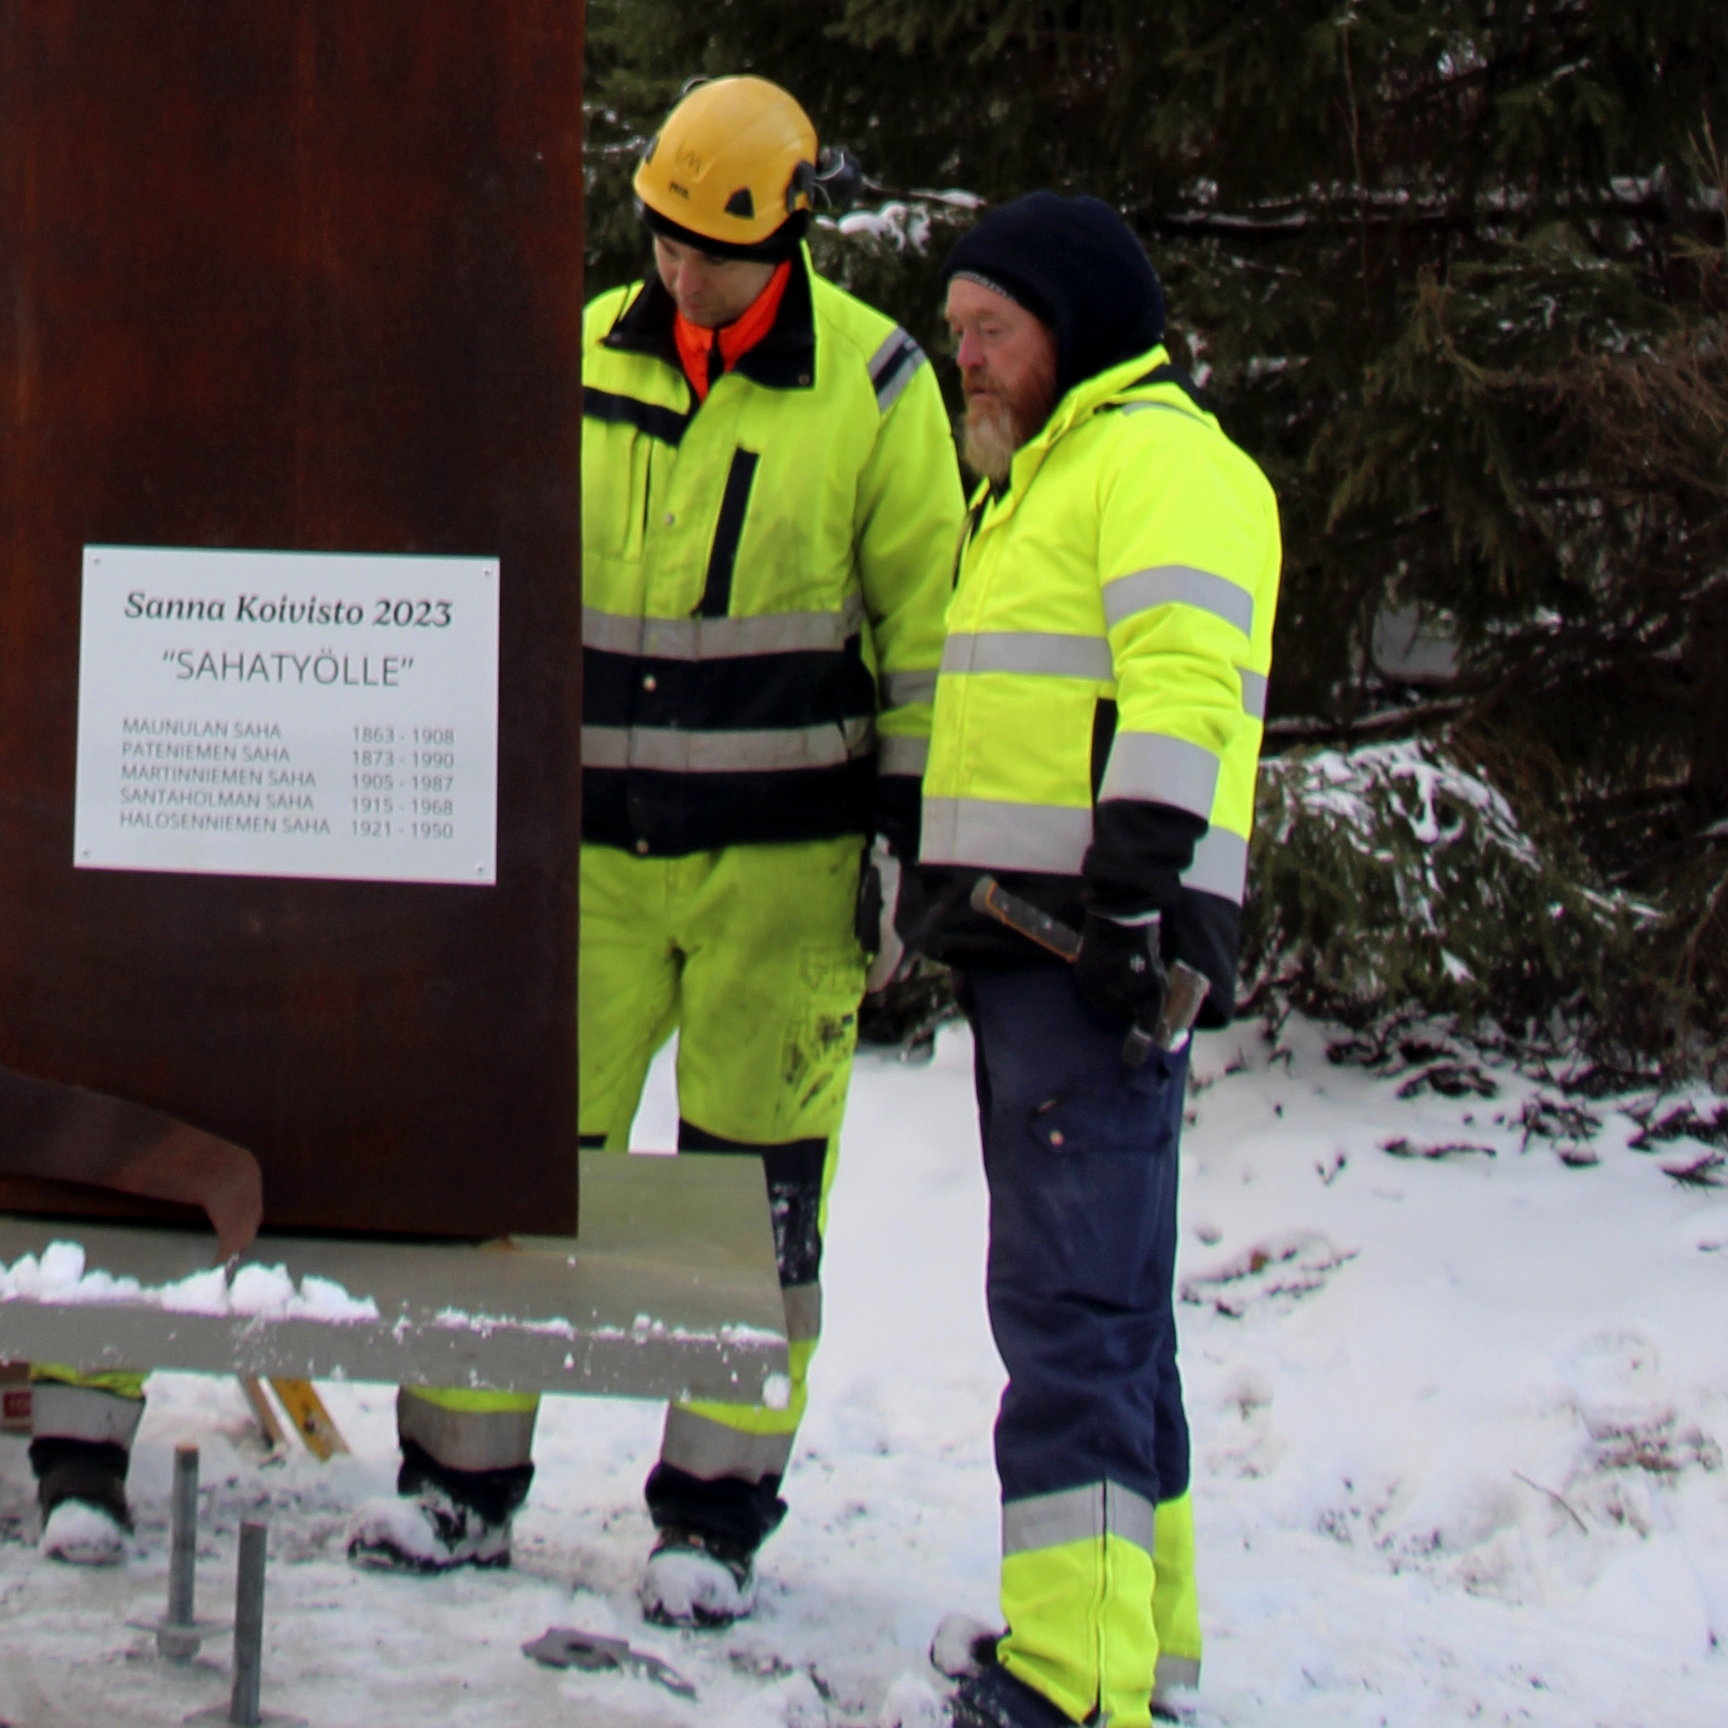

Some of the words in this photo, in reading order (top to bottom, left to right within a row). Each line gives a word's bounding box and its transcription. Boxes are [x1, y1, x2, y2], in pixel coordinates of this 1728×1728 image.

[124, 590, 226, 622] Sanna
[235, 593, 365, 627] Koivisto
[373, 597, 454, 628] 2023
[122, 718, 228, 738] MAUNULAN
[233, 722, 282, 740] SAHA
[353, 726, 395, 744] 1863
[413, 728, 455, 746] 1908
[121, 741, 237, 762] PATENIEMEN
[241, 746, 291, 763] SAHA
[352, 750, 395, 767] 1873
[413, 752, 455, 769] 1990
[121, 764, 263, 786] MARTINNIEMEN
[268, 770, 316, 787] SAHA
[352, 774, 394, 791] 1905
[412, 775, 454, 793] 1987
[121, 787, 261, 809] SANTAHOLMAN
[266, 793, 315, 811] SAHA
[352, 798, 394, 815] 1915
[412, 798, 454, 816] 1968
[120, 811, 277, 834] HALOSENNIEMEN
[282, 817, 331, 835] SAHA
[351, 821, 392, 838] 1921
[412, 822, 454, 840] 1950
